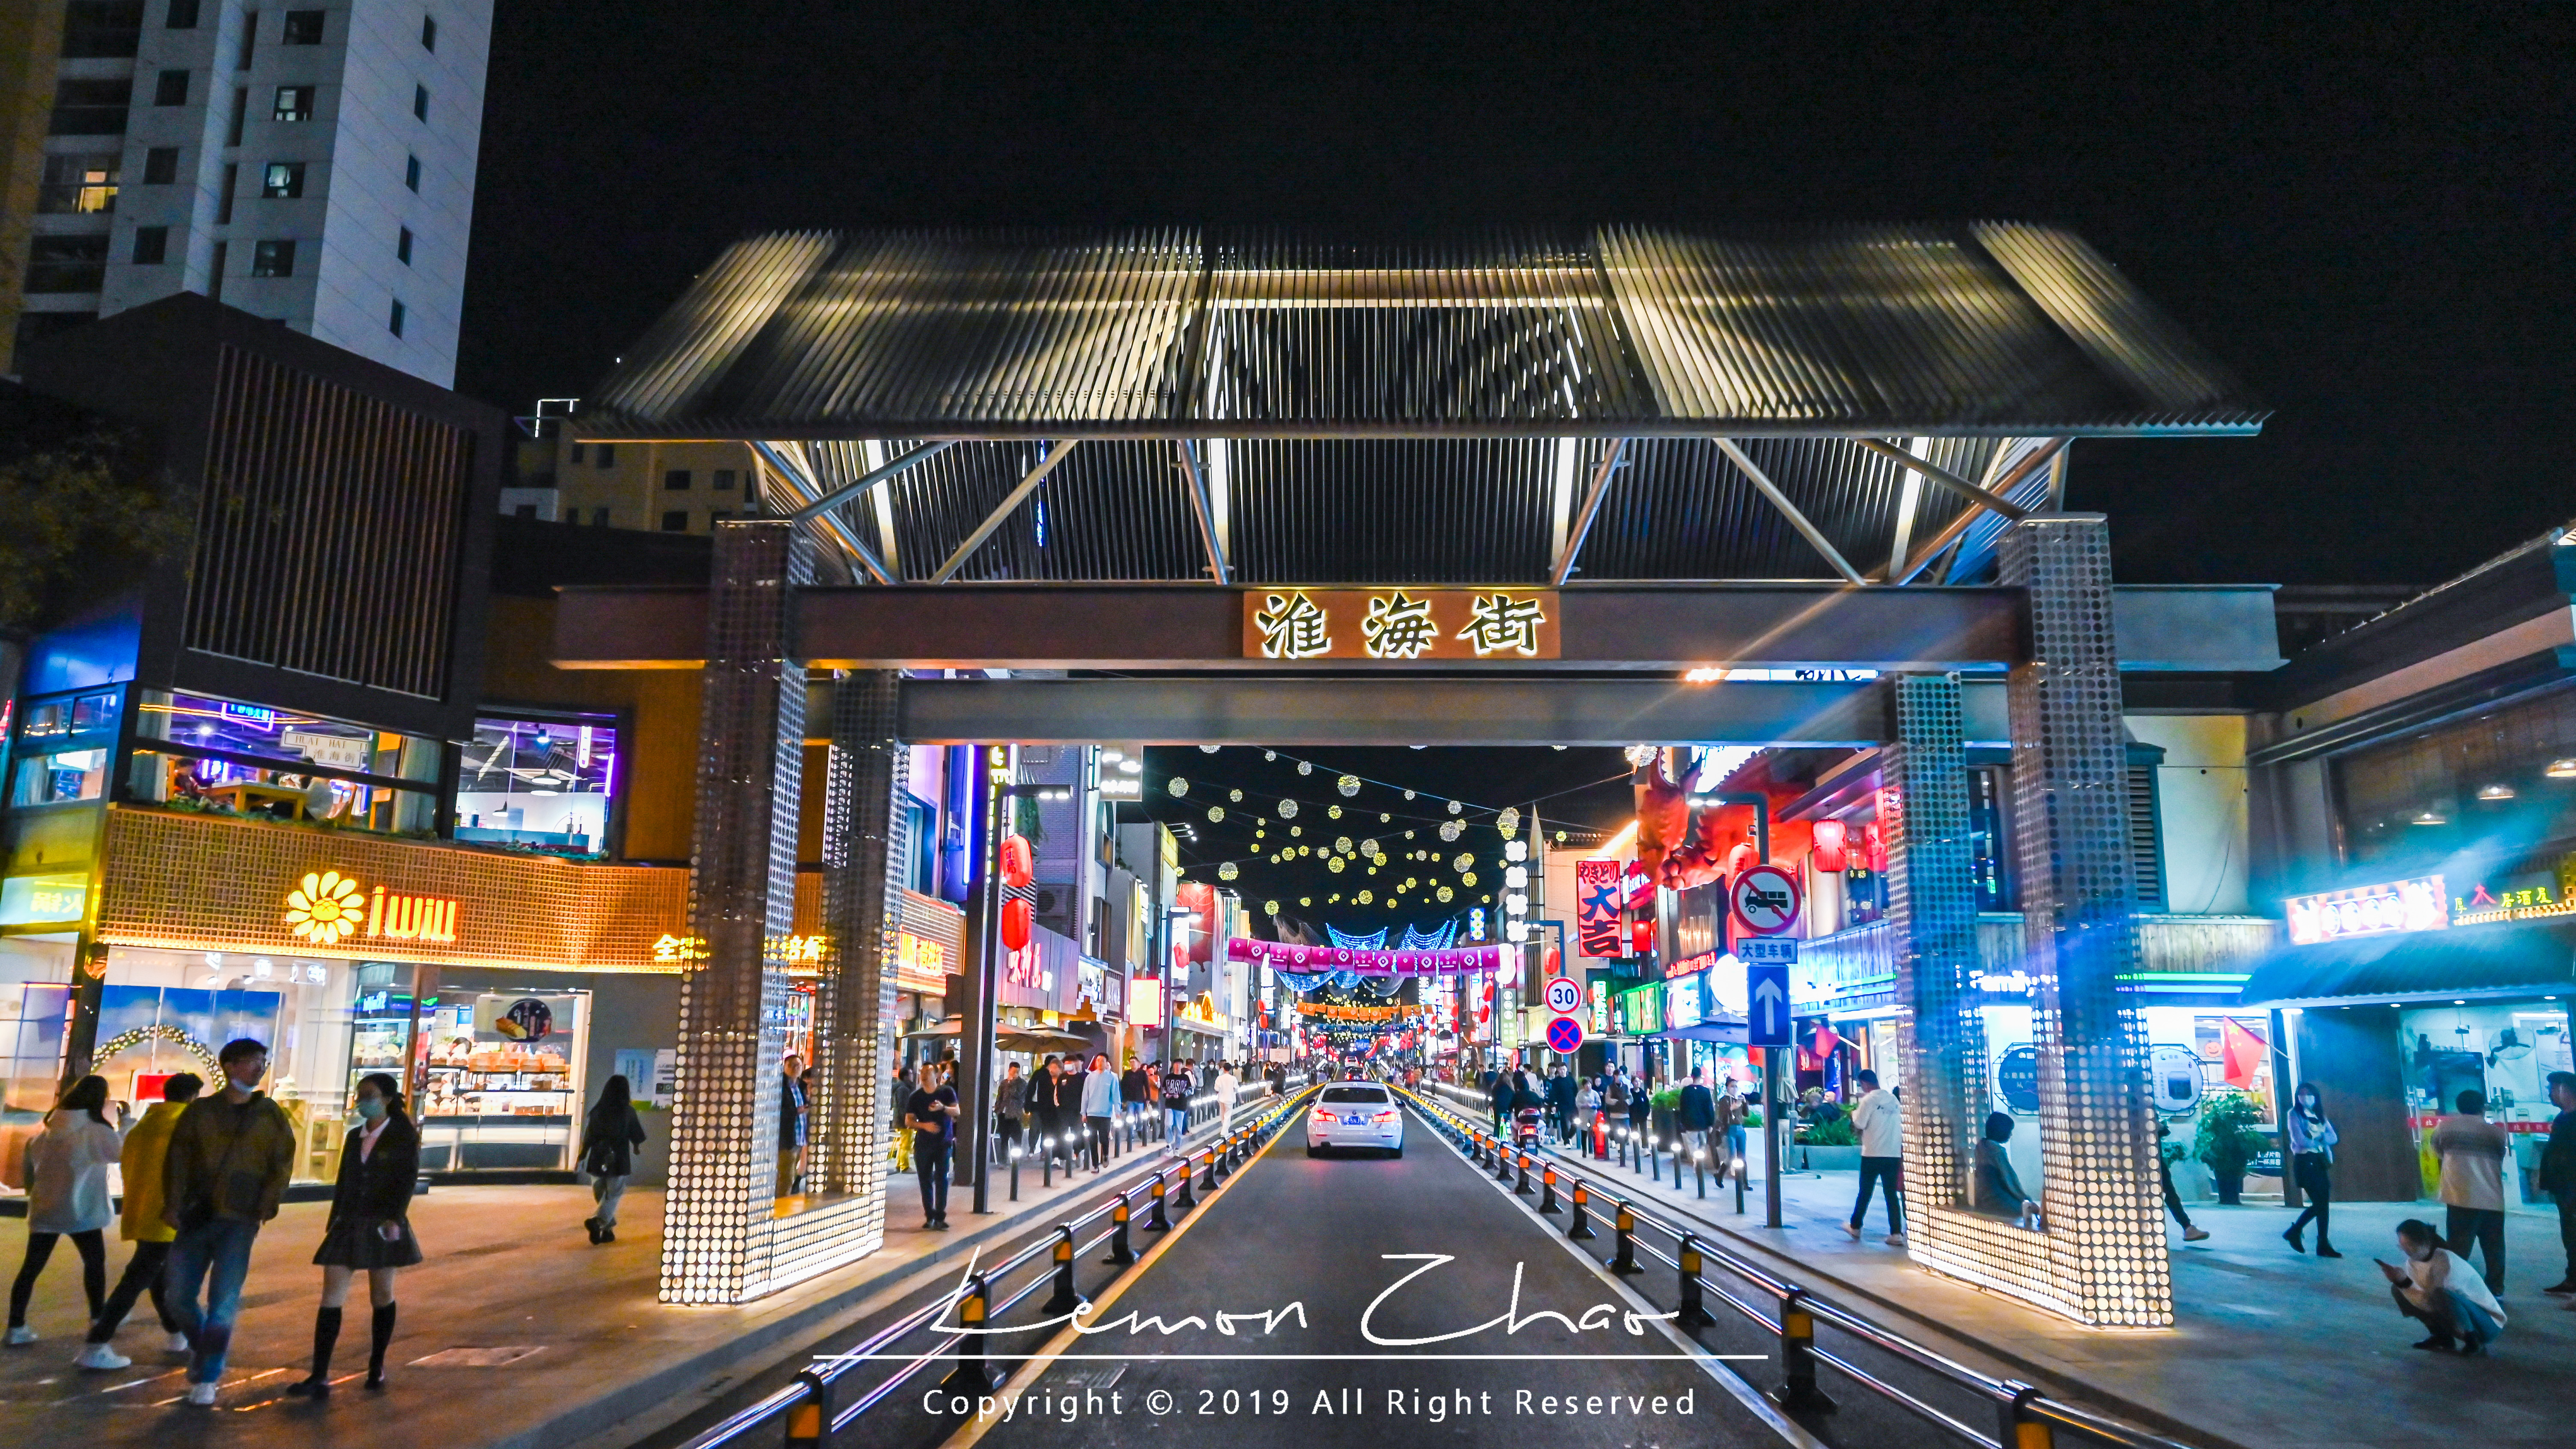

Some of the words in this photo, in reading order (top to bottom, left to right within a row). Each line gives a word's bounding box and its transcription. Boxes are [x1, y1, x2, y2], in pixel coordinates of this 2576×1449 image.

[1255, 591, 1546, 659] 淮海街
[329, 739, 346, 748] HAI
[1579, 885, 1621, 955] 大吉
[1741, 943, 1793, 959] 大型车辆
[1553, 988, 1574, 1005] 30
